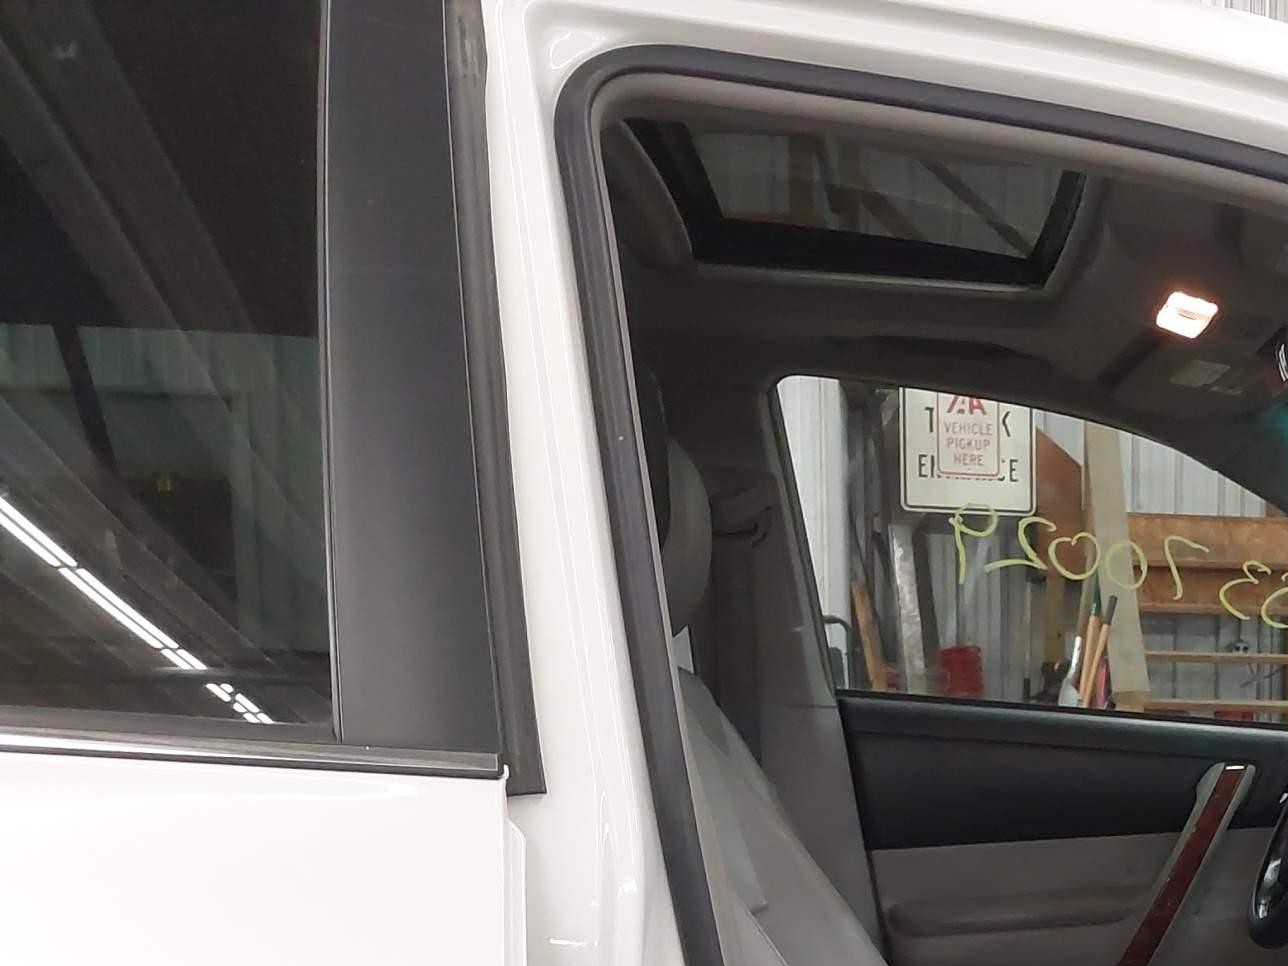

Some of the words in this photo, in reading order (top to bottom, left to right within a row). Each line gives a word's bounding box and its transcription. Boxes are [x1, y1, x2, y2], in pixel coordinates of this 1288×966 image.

[943, 421, 993, 436] VEHICLE
[946, 437, 991, 451] PICKUP
[953, 453, 984, 466] HERE
